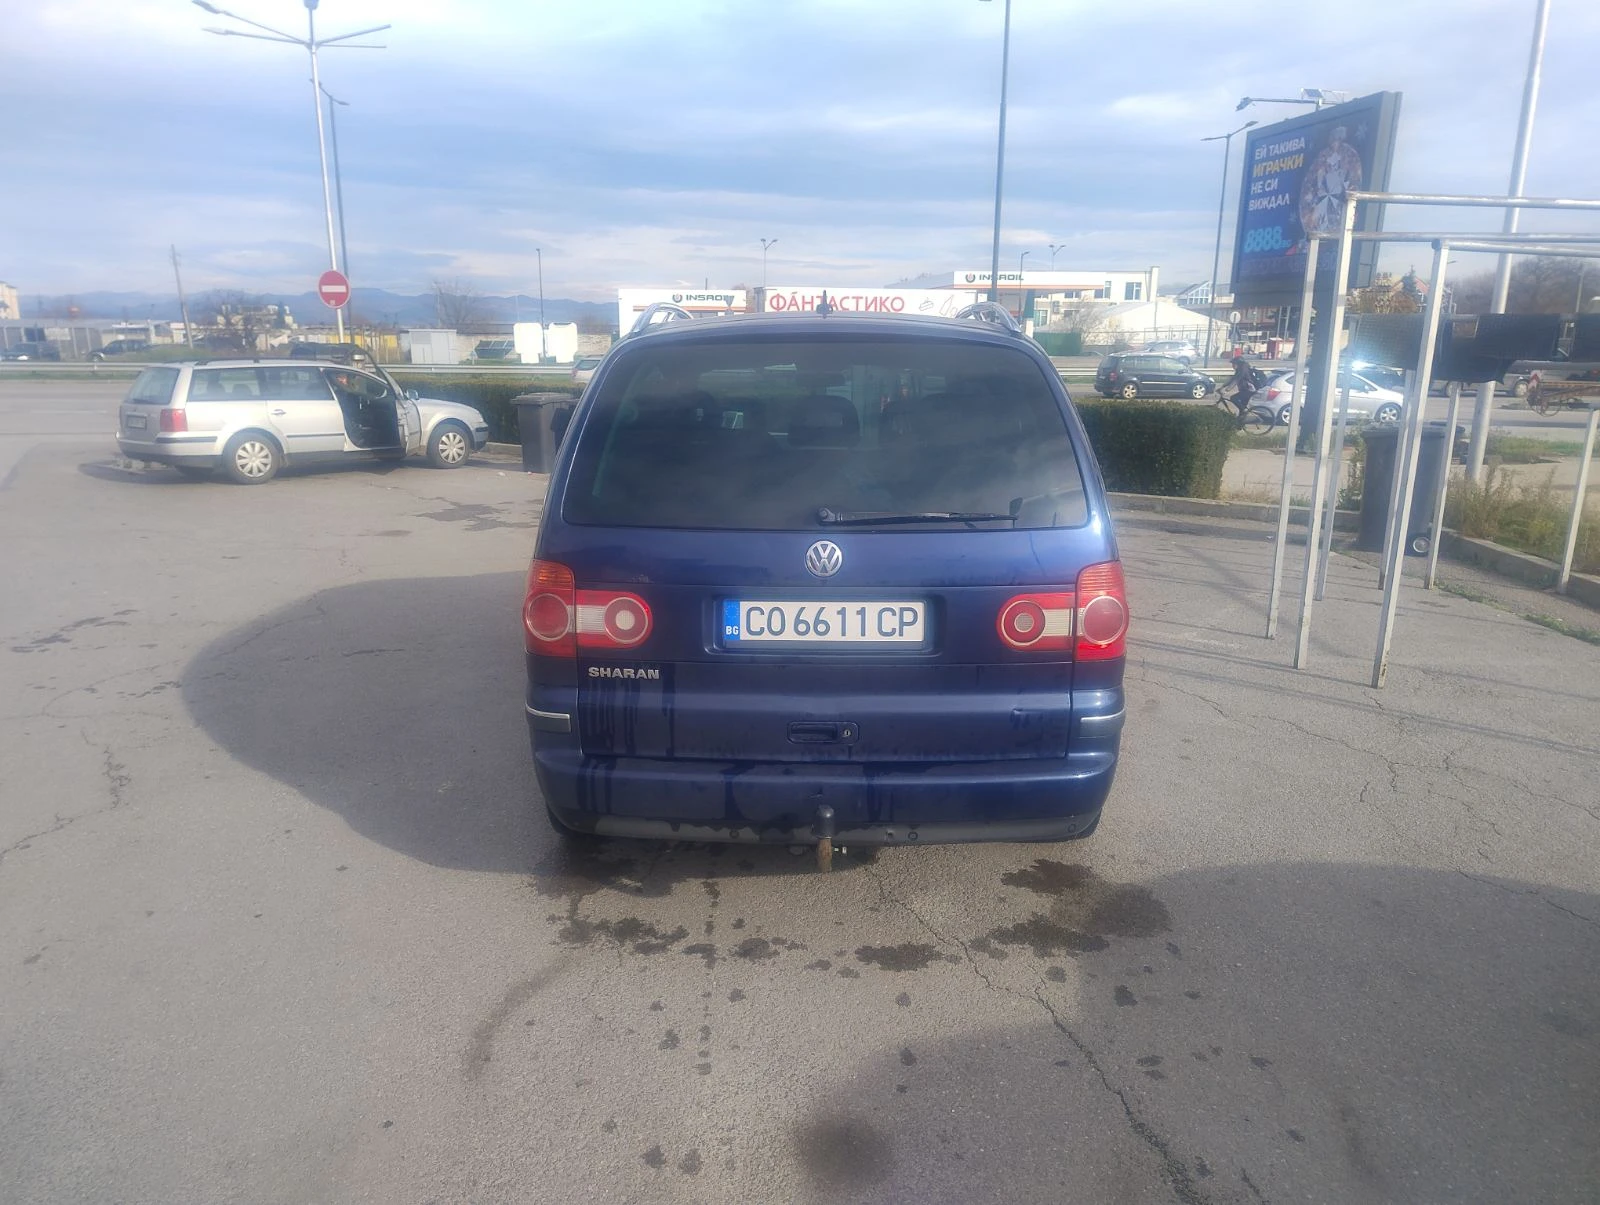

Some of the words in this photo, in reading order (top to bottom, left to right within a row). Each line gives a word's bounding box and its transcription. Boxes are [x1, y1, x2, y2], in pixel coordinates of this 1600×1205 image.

[1253, 153, 1304, 177] ИГРАЧКИ
[1251, 181, 1263, 195] НЕ
[1265, 178, 1278, 191] СИ
[725, 625, 739, 635] BG
[588, 666, 660, 680] SHARAN
